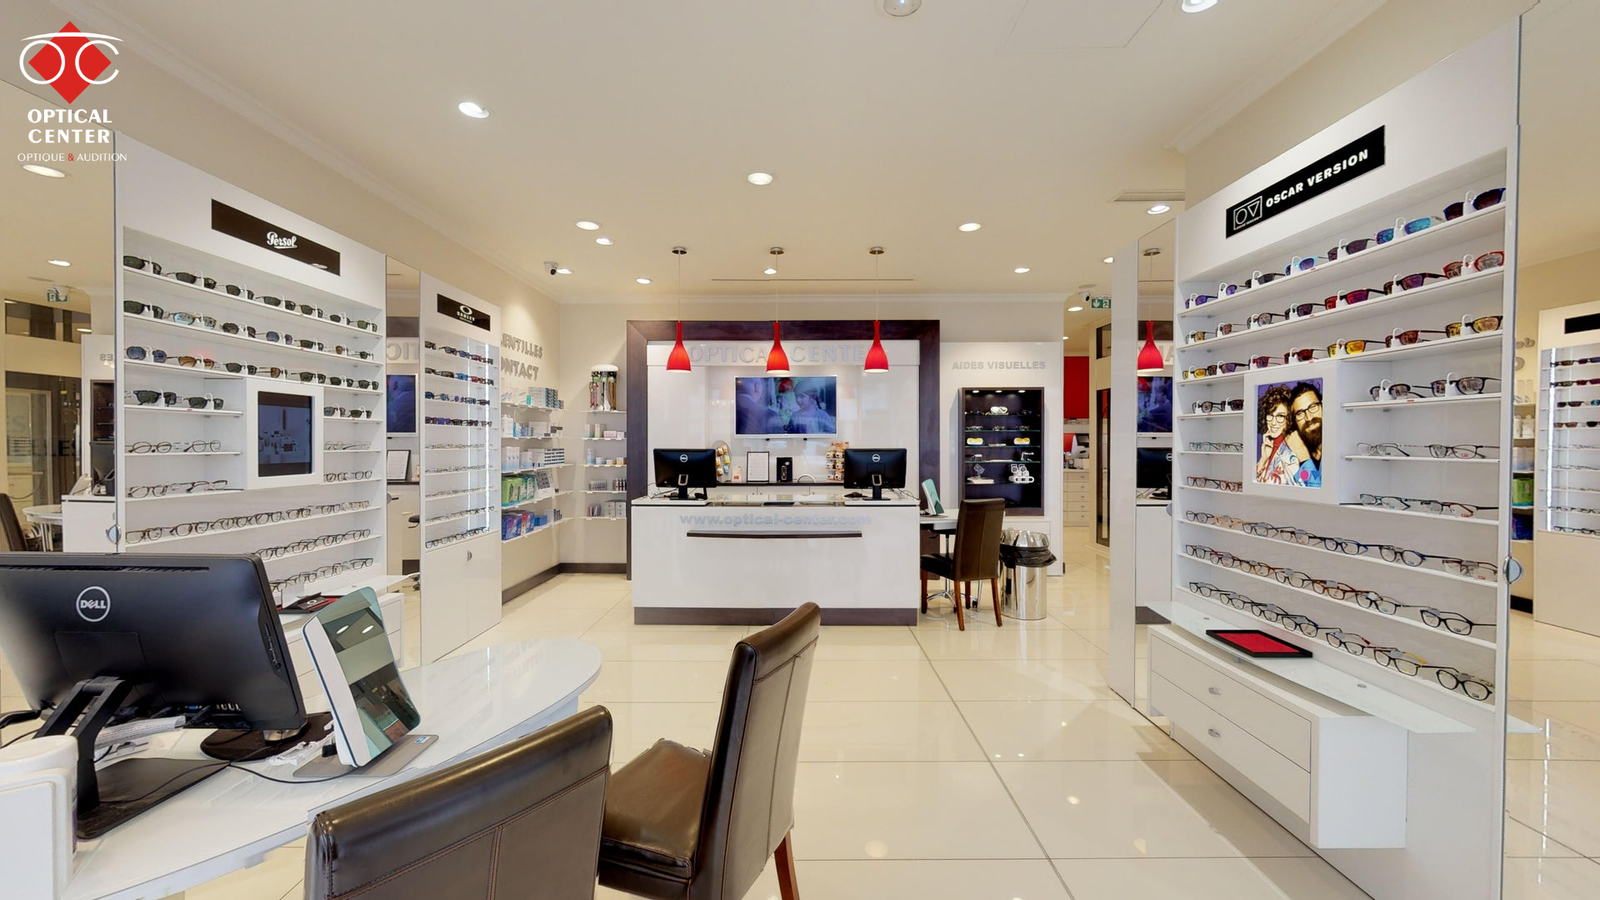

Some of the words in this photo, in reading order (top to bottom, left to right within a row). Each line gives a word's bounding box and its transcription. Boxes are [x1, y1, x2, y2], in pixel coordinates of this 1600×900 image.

[1265, 182, 1304, 208] OSCAR
[1307, 149, 1369, 187] VERSION
[266, 231, 298, 249] Persol
[501, 333, 543, 360] ENTILLES
[688, 345, 768, 364] OPTICA
[789, 345, 866, 363] CENTE
[952, 361, 985, 370] AIDES
[987, 361, 1047, 370] VISUELLES
[680, 513, 872, 527] www.optical-center.com
[80, 599, 107, 609] DELL
